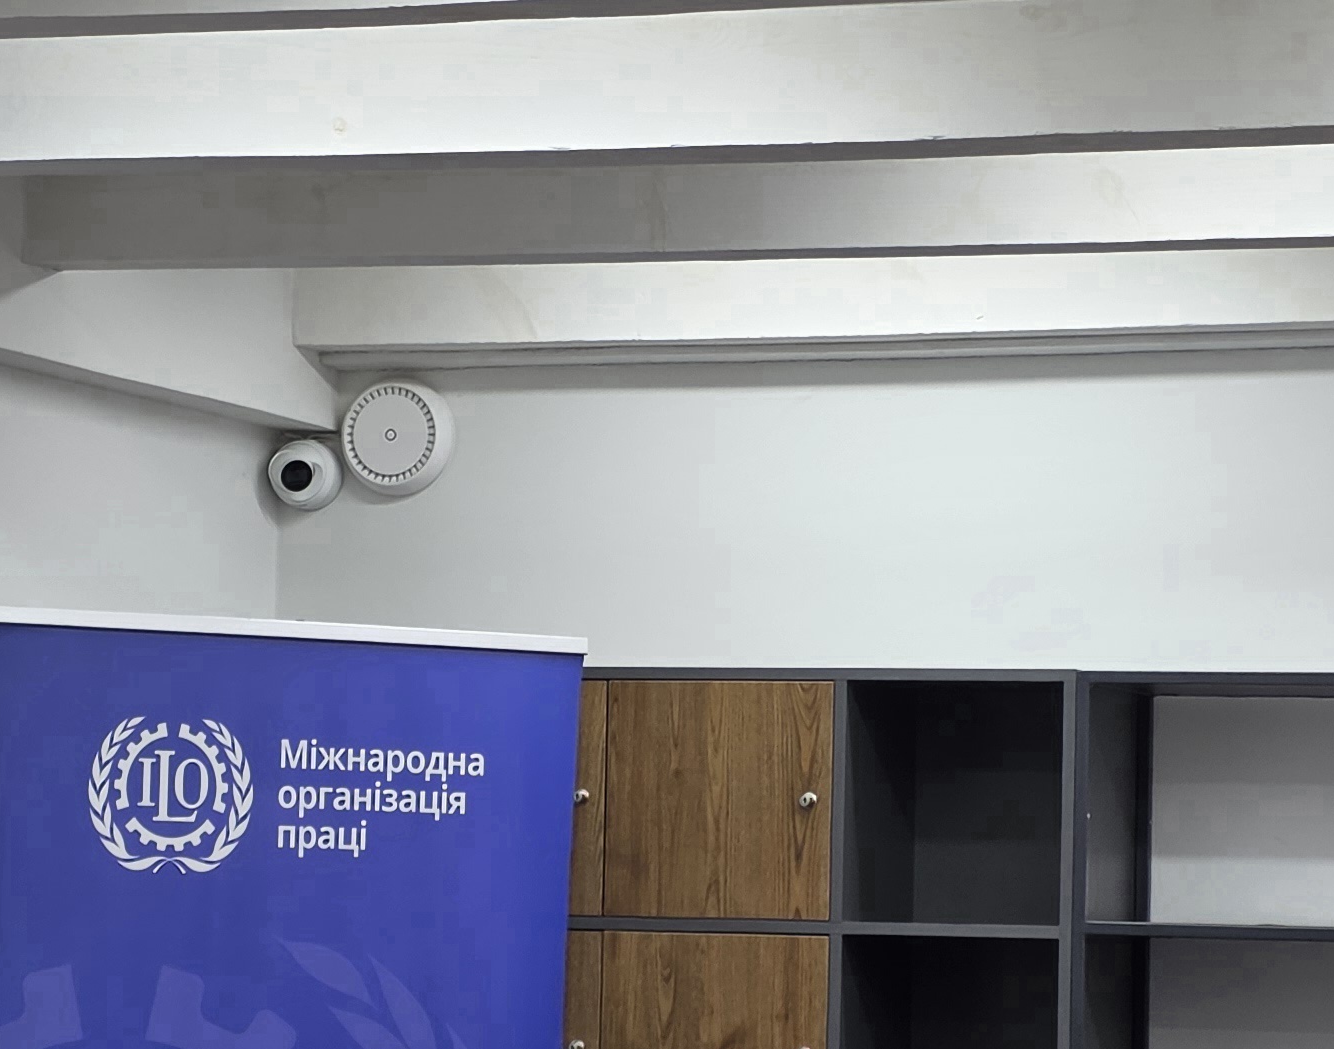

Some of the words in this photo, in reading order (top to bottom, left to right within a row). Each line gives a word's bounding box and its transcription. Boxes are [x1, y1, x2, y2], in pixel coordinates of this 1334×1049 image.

[280, 739, 485, 781] Міжнародна
[137, 750, 209, 823] ILO
[277, 783, 466, 820] організація
[277, 820, 367, 858] праці
